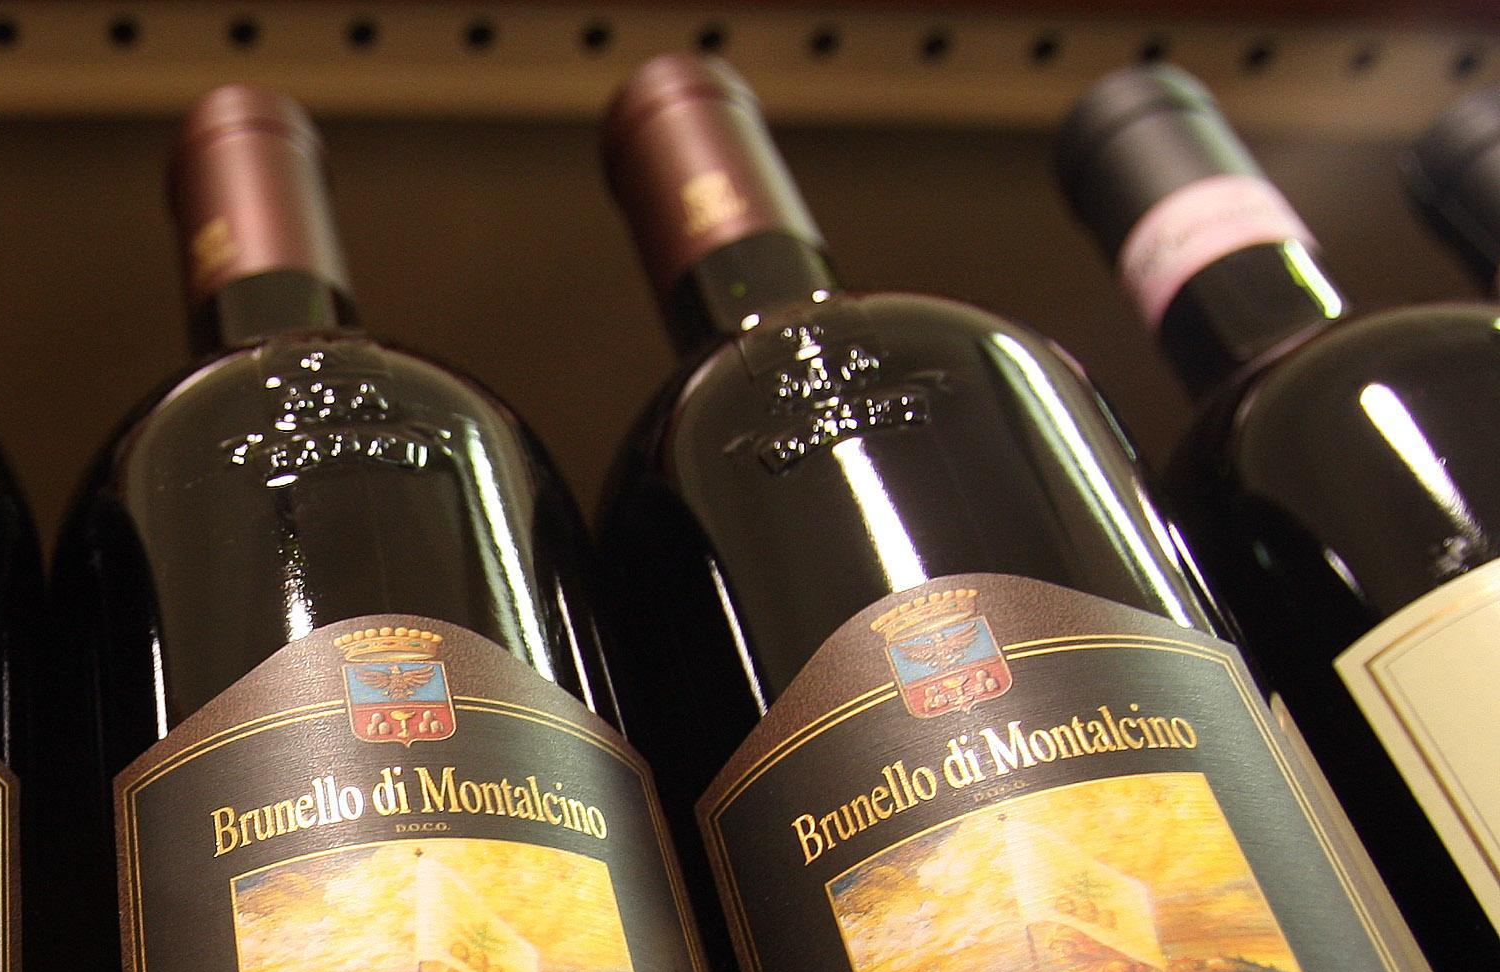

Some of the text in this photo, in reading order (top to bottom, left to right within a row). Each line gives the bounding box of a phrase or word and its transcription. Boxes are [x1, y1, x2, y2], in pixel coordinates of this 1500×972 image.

[210, 767, 609, 858] Brunello di Montalcino
[791, 703, 1198, 867] Brunello di Montalcino
